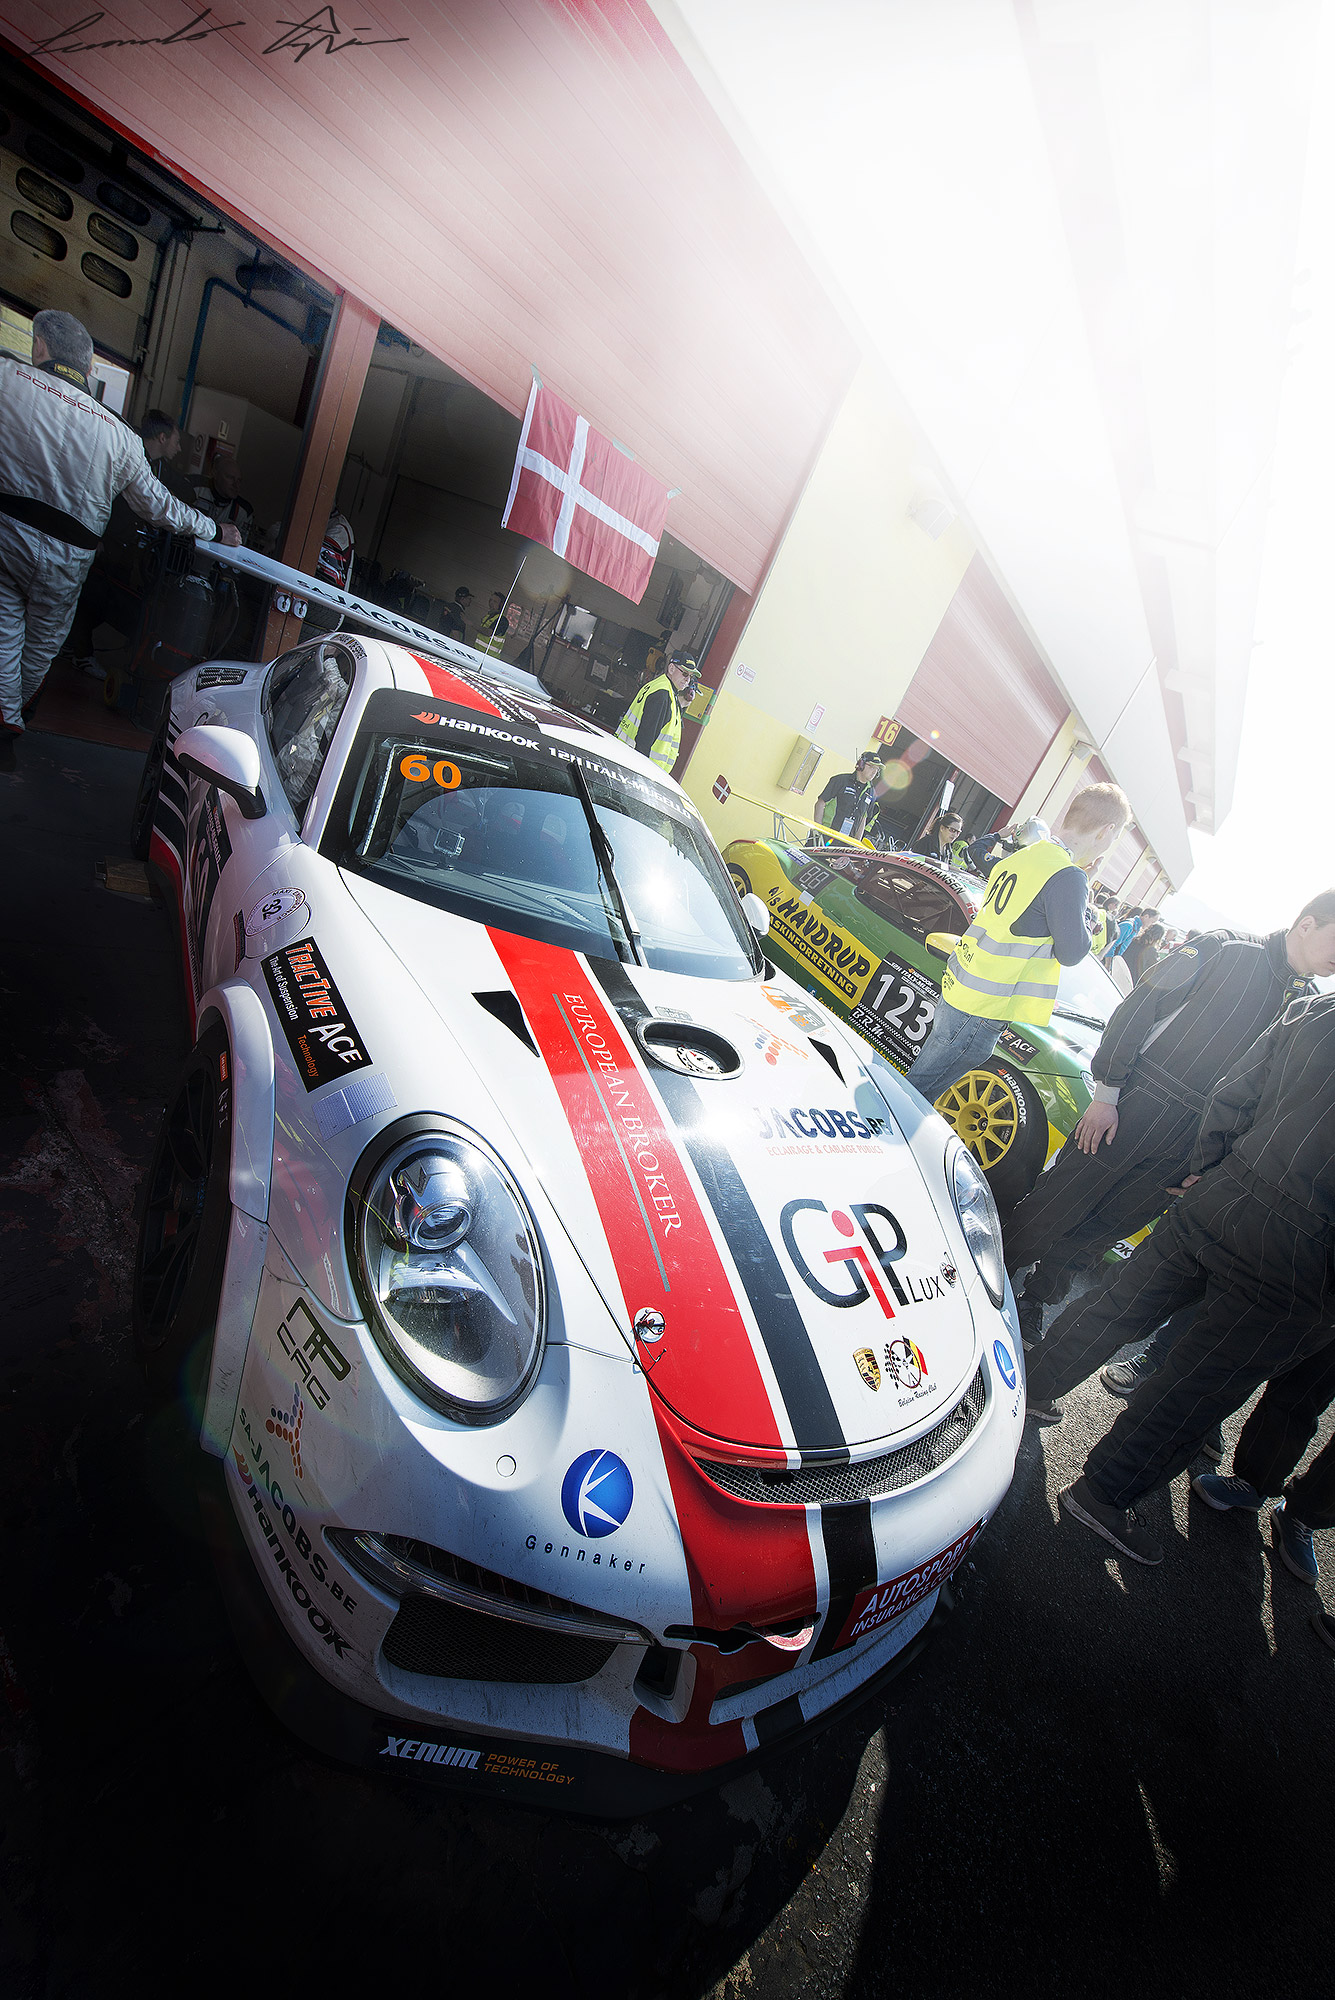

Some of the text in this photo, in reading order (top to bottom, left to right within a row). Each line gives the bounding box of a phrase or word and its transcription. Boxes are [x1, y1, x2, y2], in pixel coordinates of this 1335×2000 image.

[16, 369, 117, 428] PORSCHE
[876, 719, 899, 743] 16
[399, 754, 462, 790] 60
[930, 868, 965, 896] HANSEN
[984, 870, 1017, 916] 60
[769, 915, 855, 995] ASKINFORRETNING
[776, 897, 871, 979] HAVDRUP
[269, 955, 279, 968] The
[278, 980, 299, 1021] Suspension
[901, 969, 940, 1000] ITALY-MUGELL
[872, 974, 935, 1041] 123
[297, 1034, 319, 1077] Technology
[308, 1022, 363, 1064] ACE
[1010, 1039, 1036, 1054] ACE
[564, 992, 683, 1238] EUROPEAN BROKER
[766, 1145, 815, 1156] ECLAIRAGE
[823, 1145, 855, 1155] CABLAGE
[857, 1145, 884, 1155] PUBLICS
[906, 1275, 945, 1303] LUX
[525, 1534, 646, 1574] Gennaker
[859, 1544, 966, 1618] AUTOSPORT
[379, 1736, 559, 1772] XENUM POWER OF
[484, 1763, 575, 1785] TECHNOLOGY
